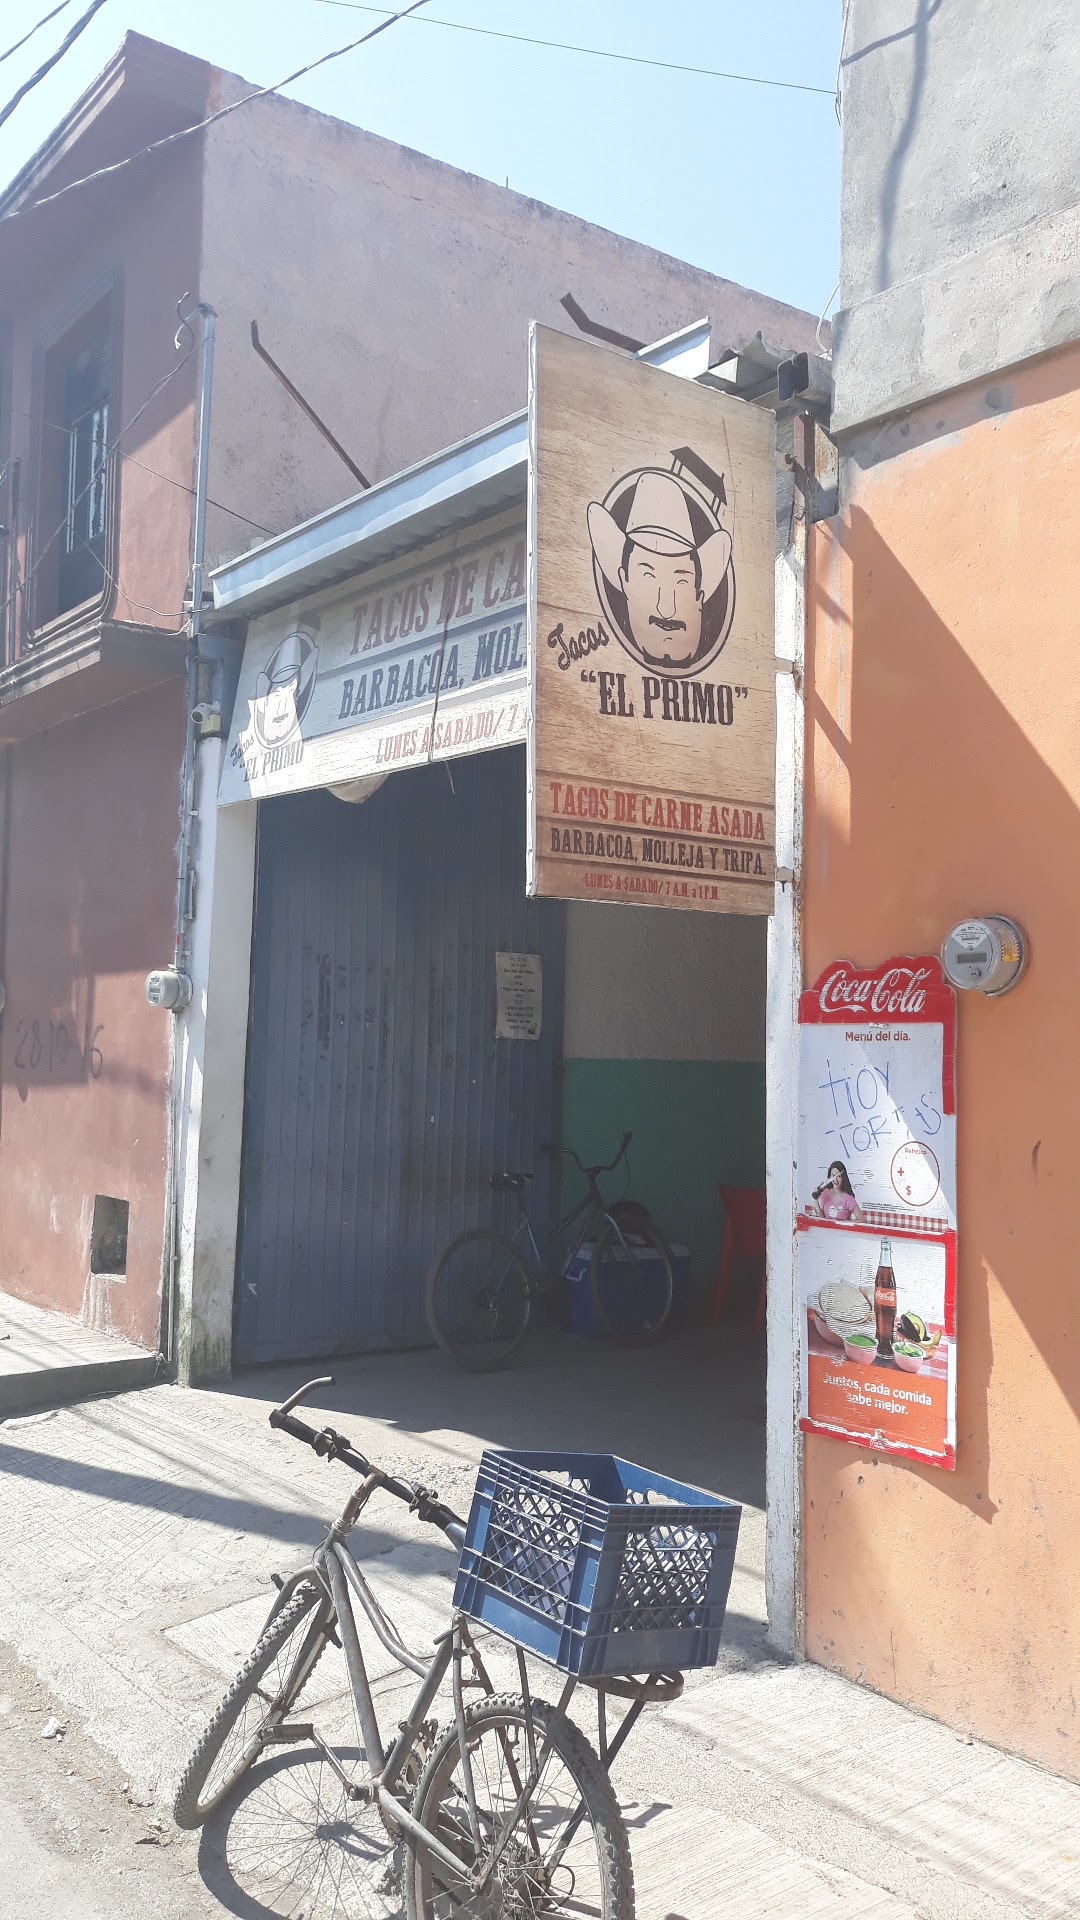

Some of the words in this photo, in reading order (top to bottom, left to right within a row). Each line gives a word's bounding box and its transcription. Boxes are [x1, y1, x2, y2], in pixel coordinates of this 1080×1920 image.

[350, 573, 434, 656] TACOS
[436, 558, 479, 626] DE
[548, 622, 609, 671] Tacos
[338, 644, 464, 720] BARBACOA,
[472, 622, 528, 681] MOL
[230, 734, 254, 767] Tacos
[376, 729, 418, 764] LUNES
[420, 727, 429, 753] A
[508, 704, 518, 732] 7
[550, 782, 609, 820] TACOS
[613, 790, 637, 823] DE
[642, 796, 703, 832] CARNE
[707, 805, 765, 841] ASADA
[550, 827, 638, 862] BARBACOA,
[642, 838, 704, 869] MOLLEJA
[709, 847, 719, 870] Y
[723, 848, 767, 875] TRIPA.
[585, 872, 613, 889] LUNES
[615, 876, 621, 890] A
[666, 881, 670, 895] 7
[819, 967, 932, 1013] Coca-Cola
[845, 1031, 872, 1042] Menú
[875, 1031, 890, 1041] del
[893, 1031, 911, 1041] día.
[819, 1059, 889, 1119] HOY
[847, 1393, 871, 1406] sabe
[875, 1399, 909, 1415] mejor.
[864, 1382, 890, 1396] cada
[893, 1388, 932, 1406] comida
